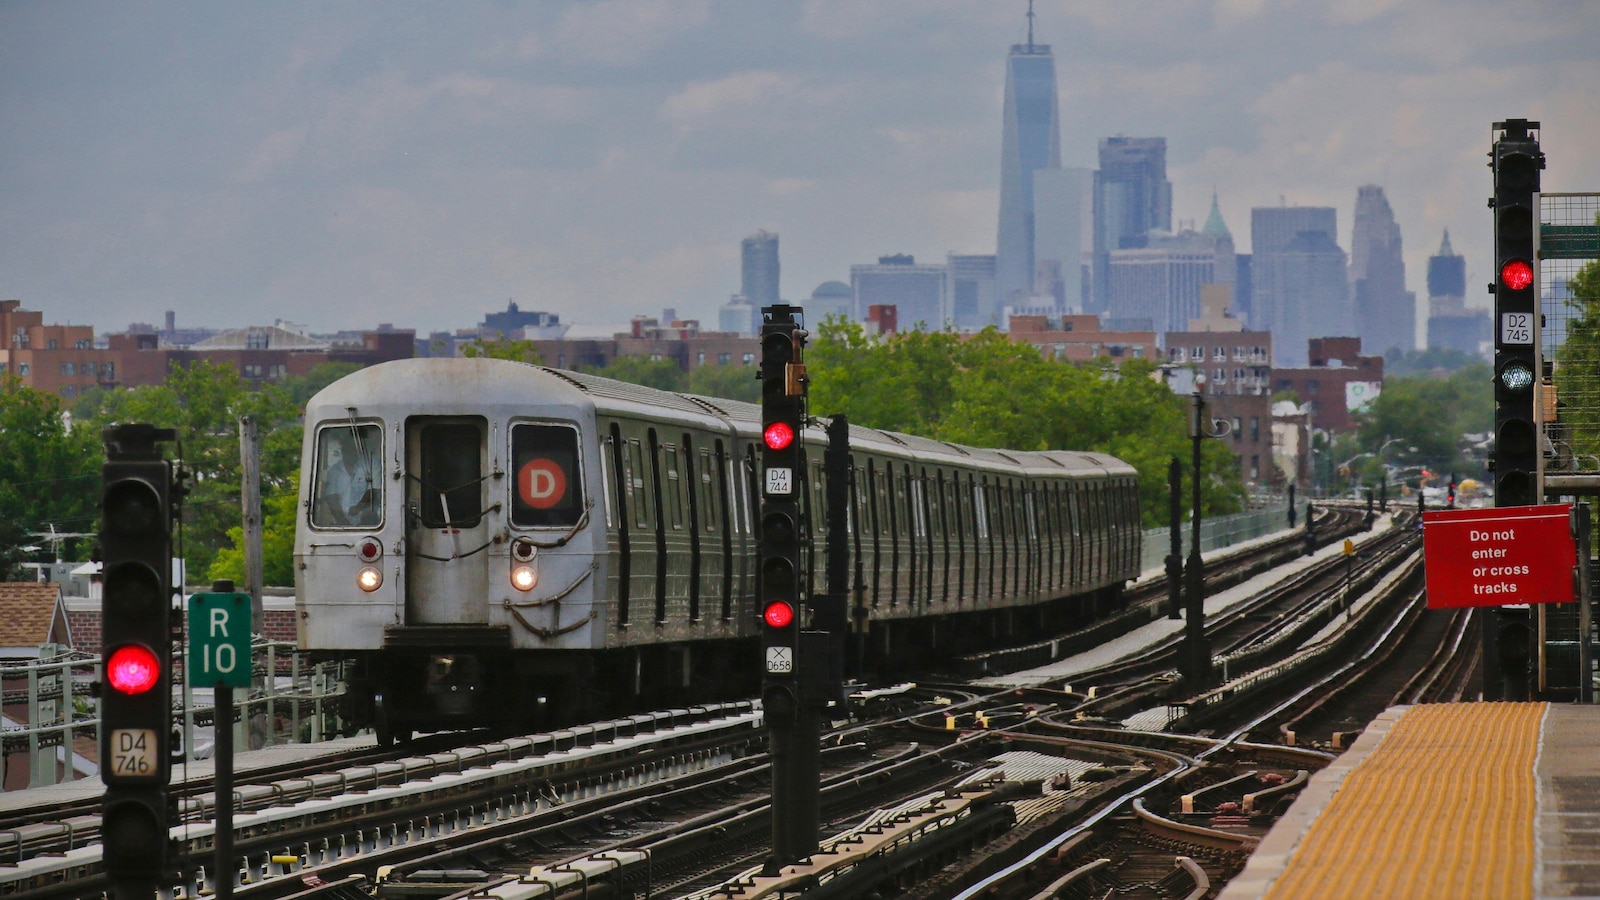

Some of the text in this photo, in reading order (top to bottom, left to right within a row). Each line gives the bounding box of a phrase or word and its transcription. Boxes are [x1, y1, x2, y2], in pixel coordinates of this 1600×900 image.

[1509, 314, 1526, 328] D2
[1506, 329, 1529, 341] 745
[771, 469, 786, 481] D4
[530, 469, 556, 499] D
[769, 482, 788, 492] 744
[1470, 528, 1515, 542] Do not
[1471, 548, 1507, 559] enter
[1472, 565, 1530, 577] or cross
[1473, 582, 1517, 595] tracks
[210, 607, 229, 638] R
[203, 643, 236, 674] 10
[773, 647, 786, 660] X
[767, 660, 791, 671] D658
[120, 731, 146, 753] D4
[115, 755, 149, 774] 746
